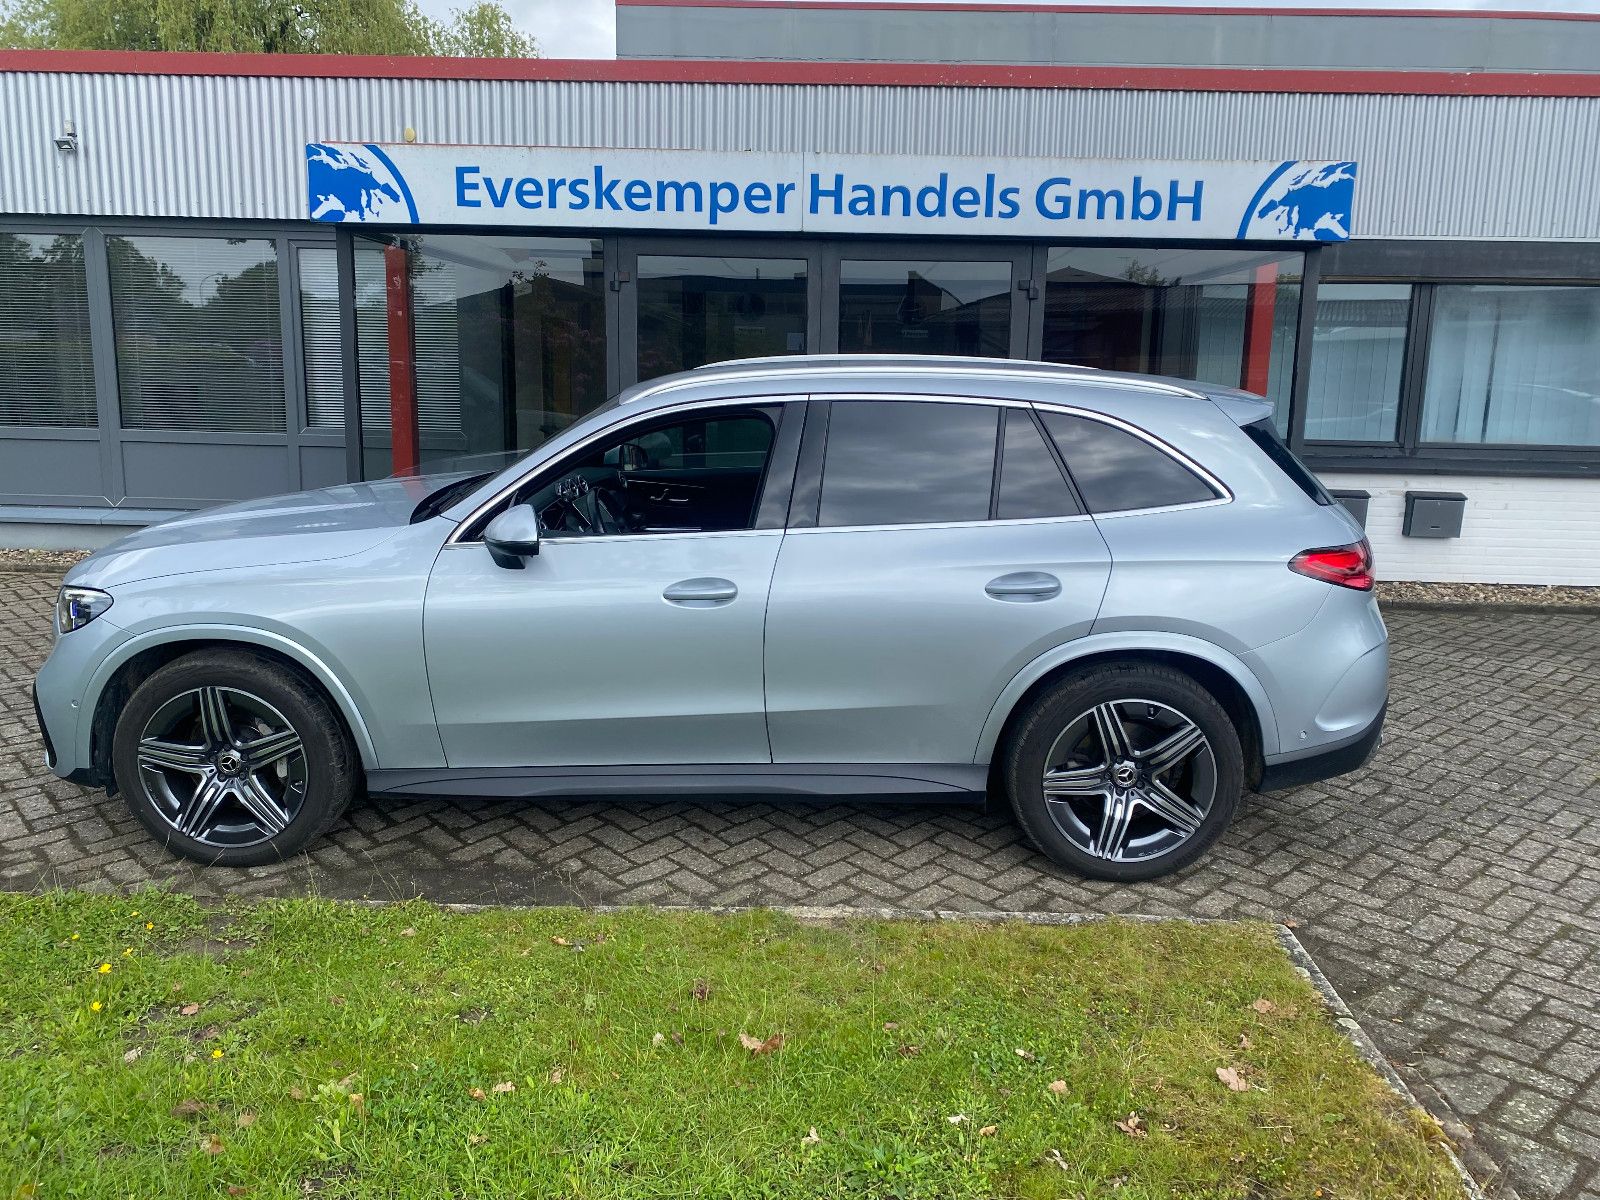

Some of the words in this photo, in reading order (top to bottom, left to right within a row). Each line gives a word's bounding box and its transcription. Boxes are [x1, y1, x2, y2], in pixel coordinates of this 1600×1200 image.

[455, 164, 796, 226] Everskemper
[808, 171, 1021, 221] Handels
[1034, 175, 1205, 223] GmbH
